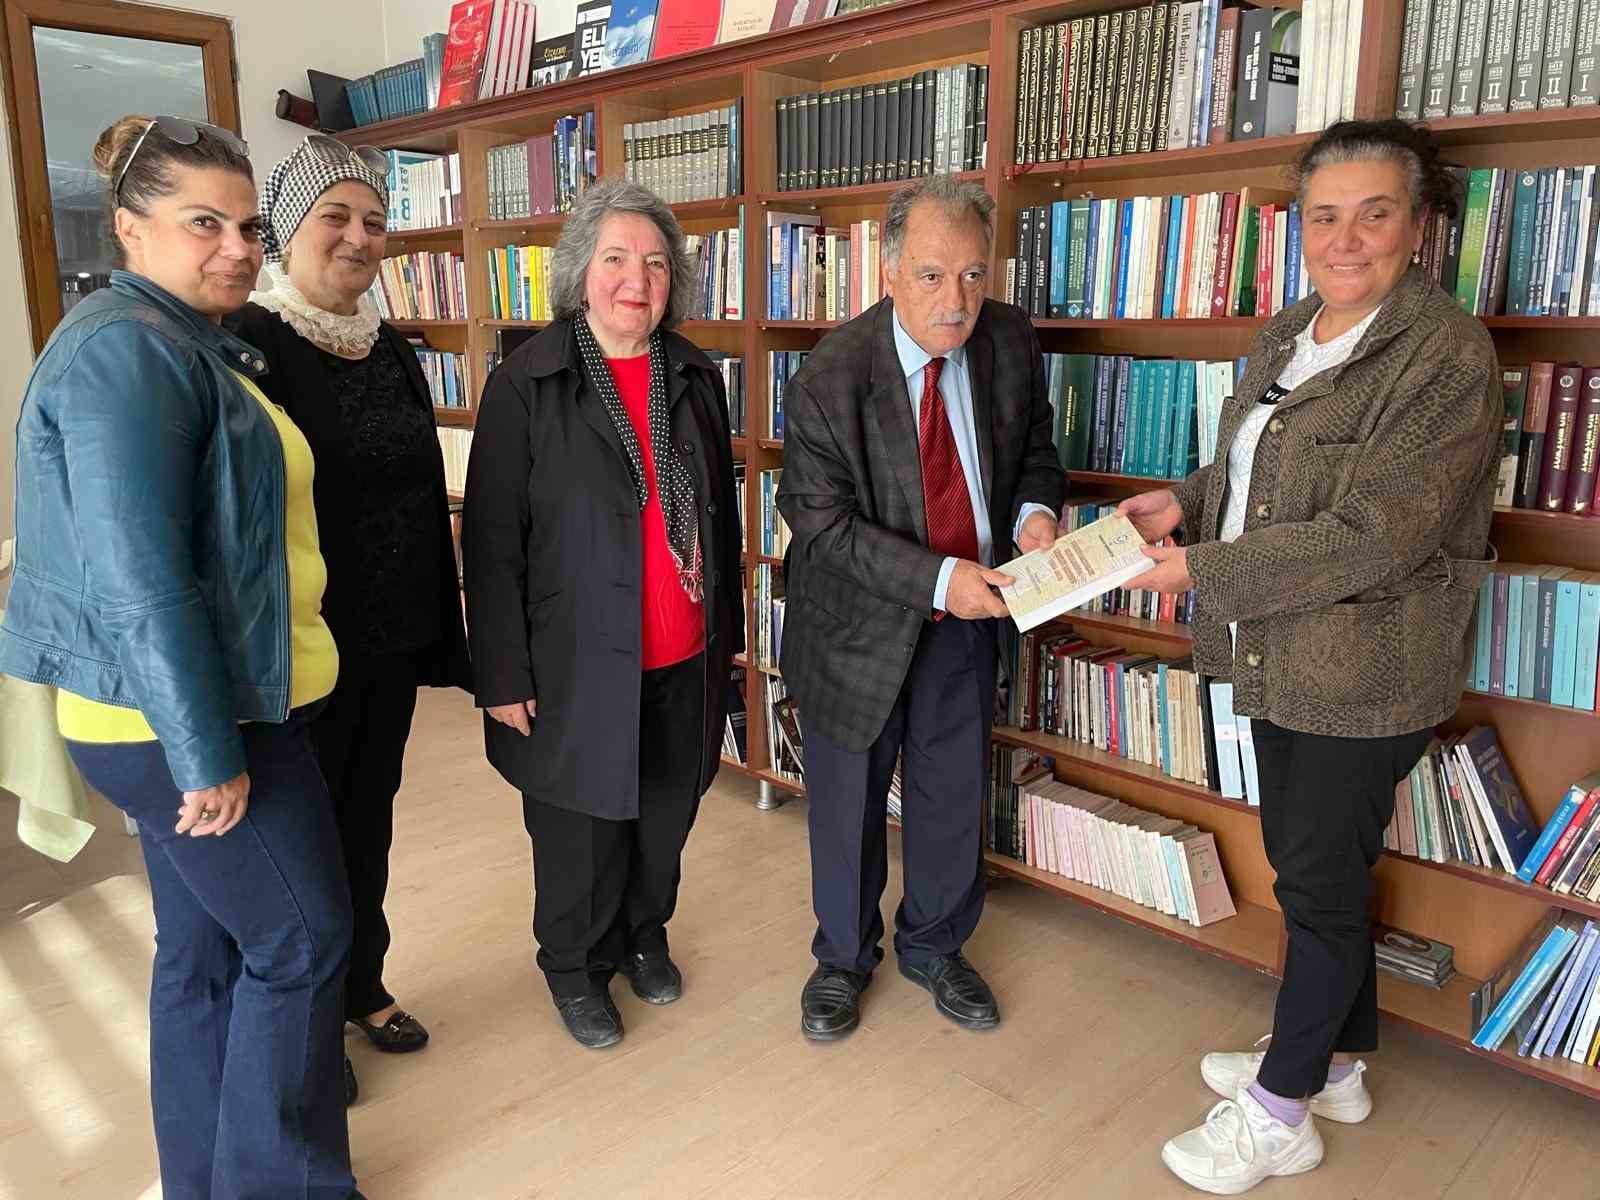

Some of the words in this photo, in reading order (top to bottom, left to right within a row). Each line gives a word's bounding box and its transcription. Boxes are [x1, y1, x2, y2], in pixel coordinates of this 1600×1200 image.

[1488, 83, 1500, 99] II
[1520, 80, 1527, 96] I
[1548, 78, 1560, 94] II
[1581, 75, 1588, 91] I
[1403, 91, 1410, 107] I
[1430, 89, 1442, 105] II
[1460, 86, 1467, 101] I
[1221, 233, 1229, 258] SÜRGÜN
[1220, 260, 1227, 268] VE
[1217, 269, 1226, 287] ÖLÜM
